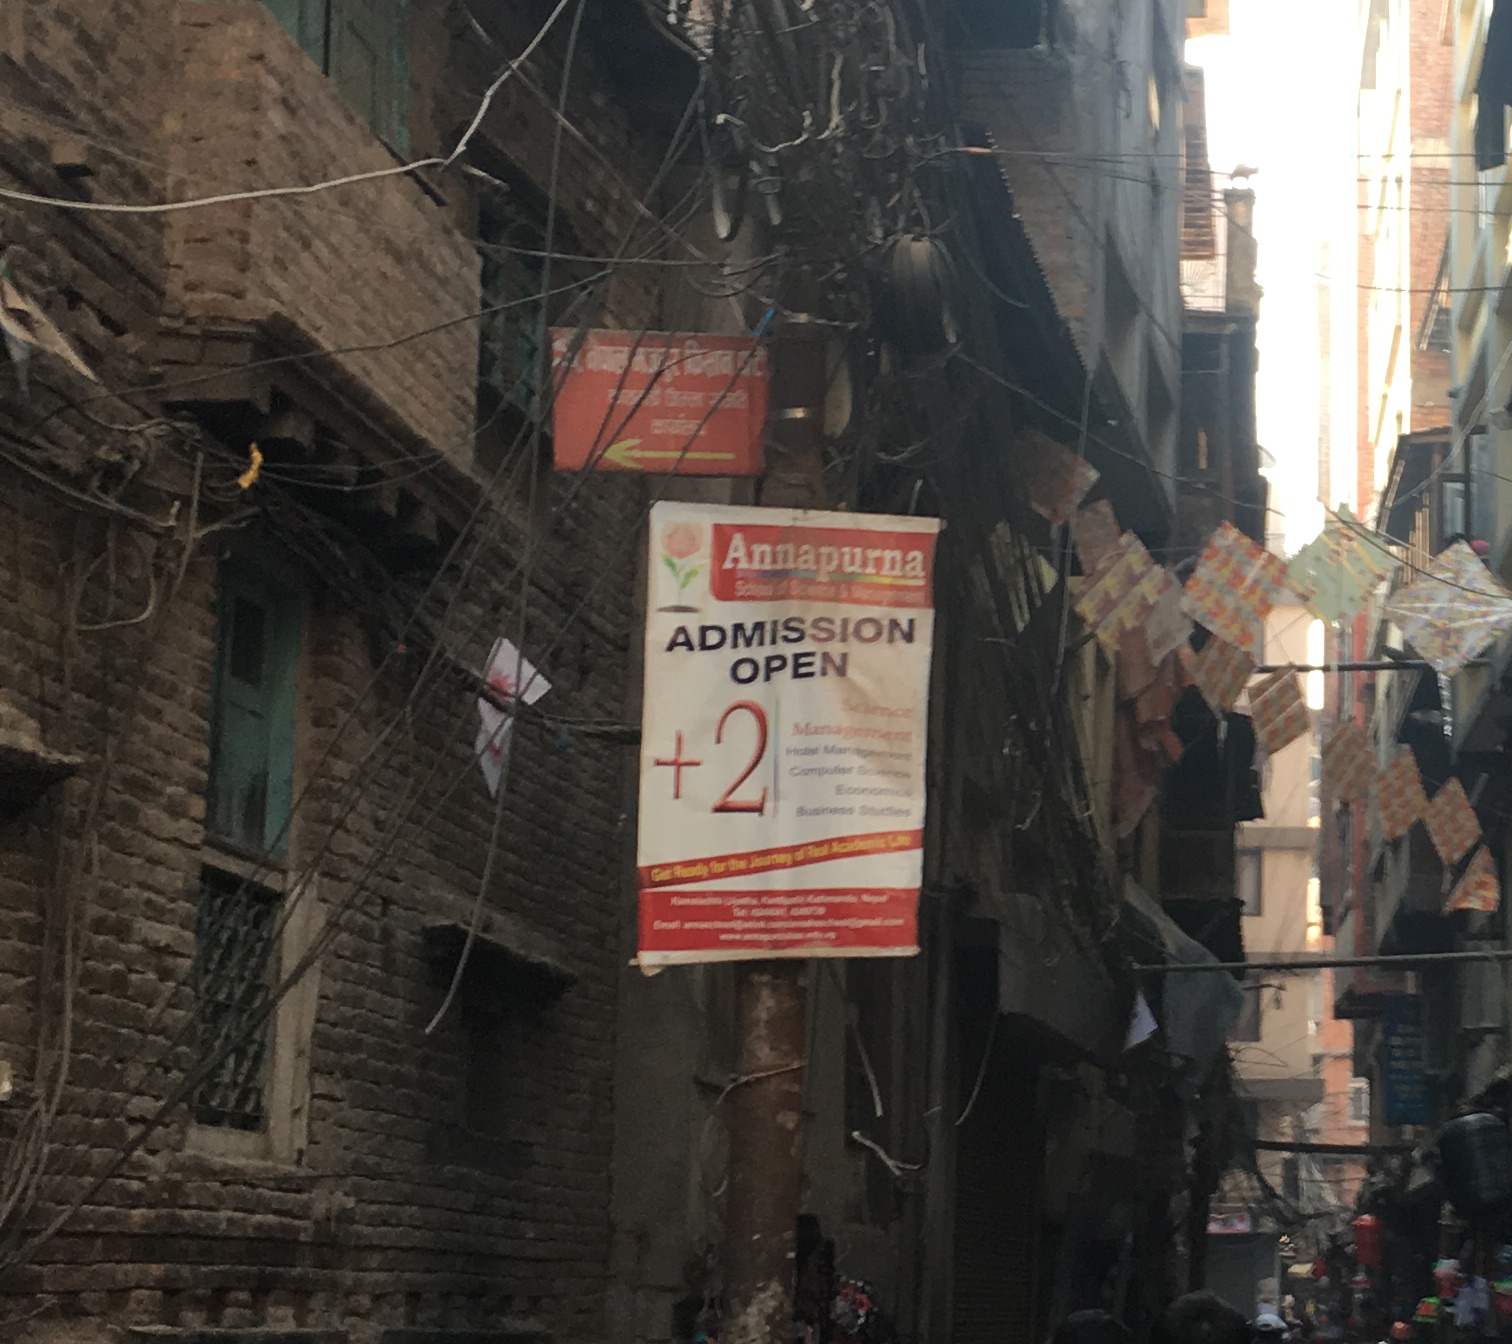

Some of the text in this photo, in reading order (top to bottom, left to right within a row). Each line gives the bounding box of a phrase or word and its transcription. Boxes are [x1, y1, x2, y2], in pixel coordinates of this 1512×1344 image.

[722, 532, 926, 582] Annapurna
[665, 617, 917, 653] ADMISSION
[729, 652, 849, 685] OPEN
[841, 697, 914, 718] Science
[792, 721, 913, 742] Management
[653, 699, 768, 816] +2
[788, 765, 854, 777] Computer
[795, 804, 912, 817] Business Studies
[750, 853, 793, 869] Journey
